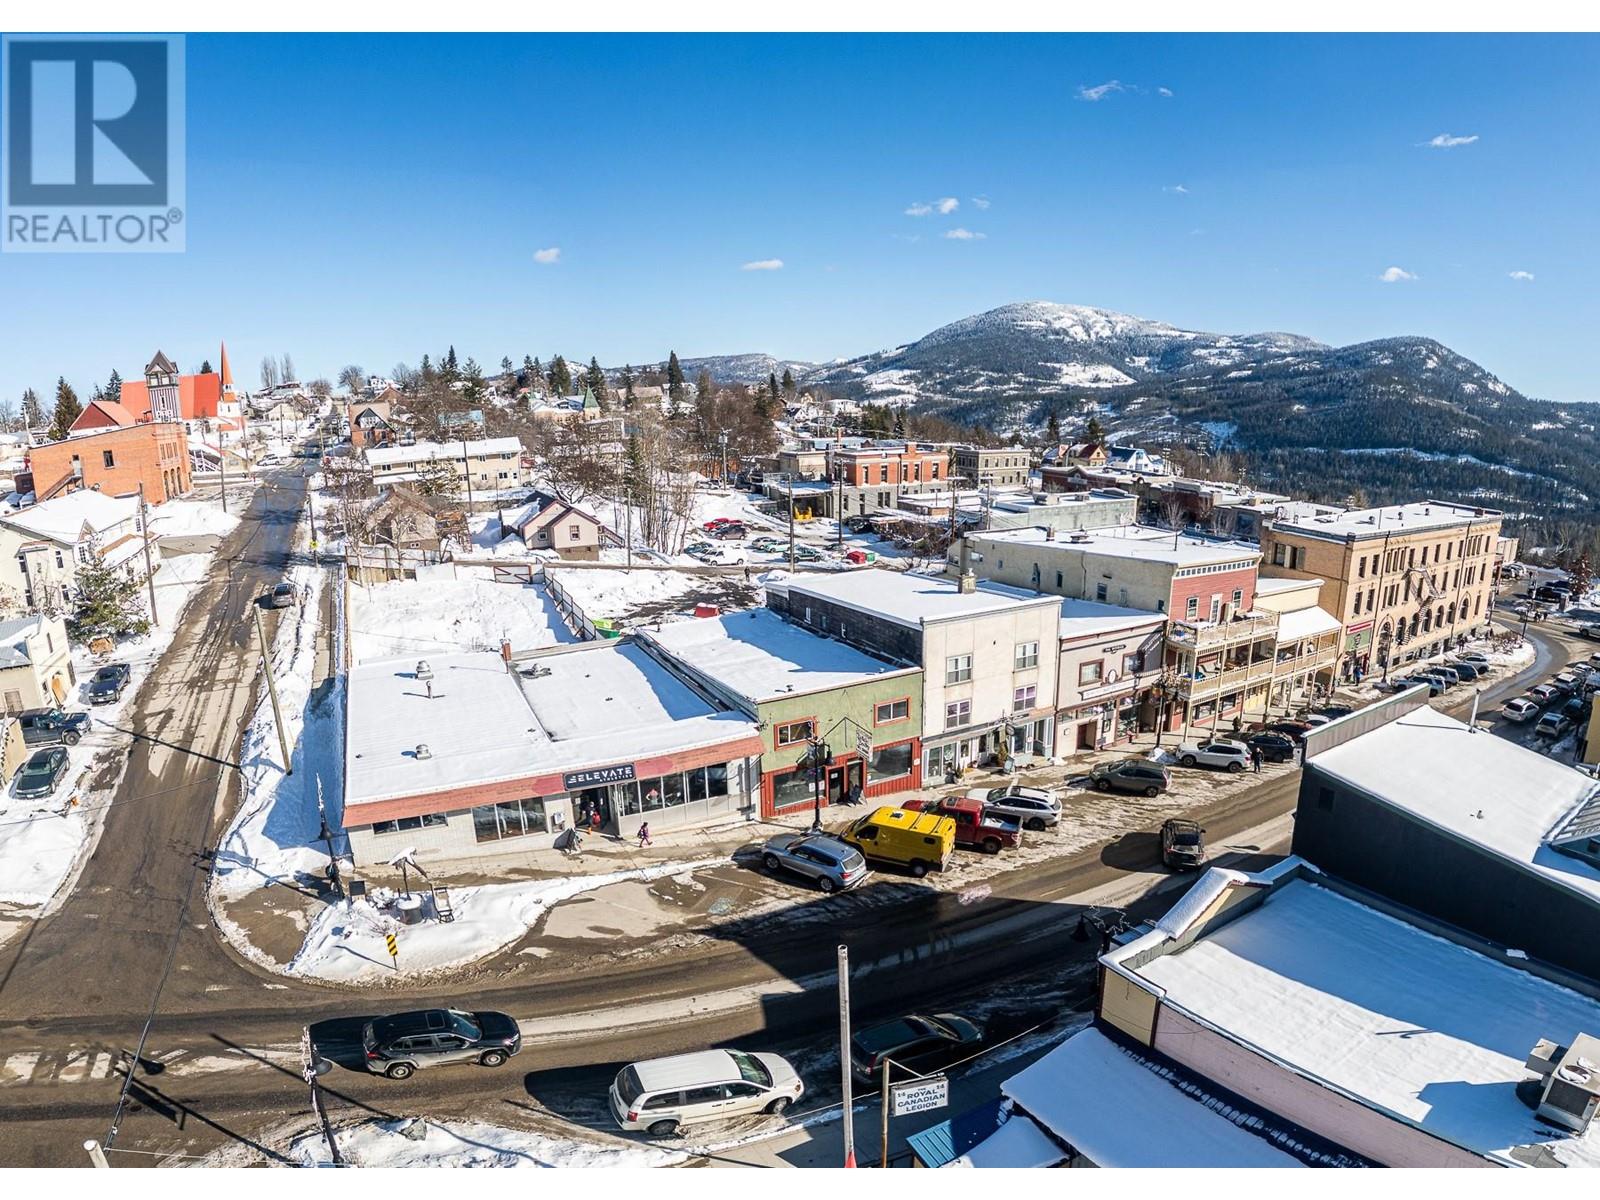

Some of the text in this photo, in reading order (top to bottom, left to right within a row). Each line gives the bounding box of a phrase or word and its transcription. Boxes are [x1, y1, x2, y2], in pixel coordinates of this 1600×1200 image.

[577, 766, 632, 782] ELEVATE
[897, 1093, 945, 1107] CANADIAN
[907, 1089, 938, 1099] ROYAL
[906, 1101, 938, 1112] LEGION
